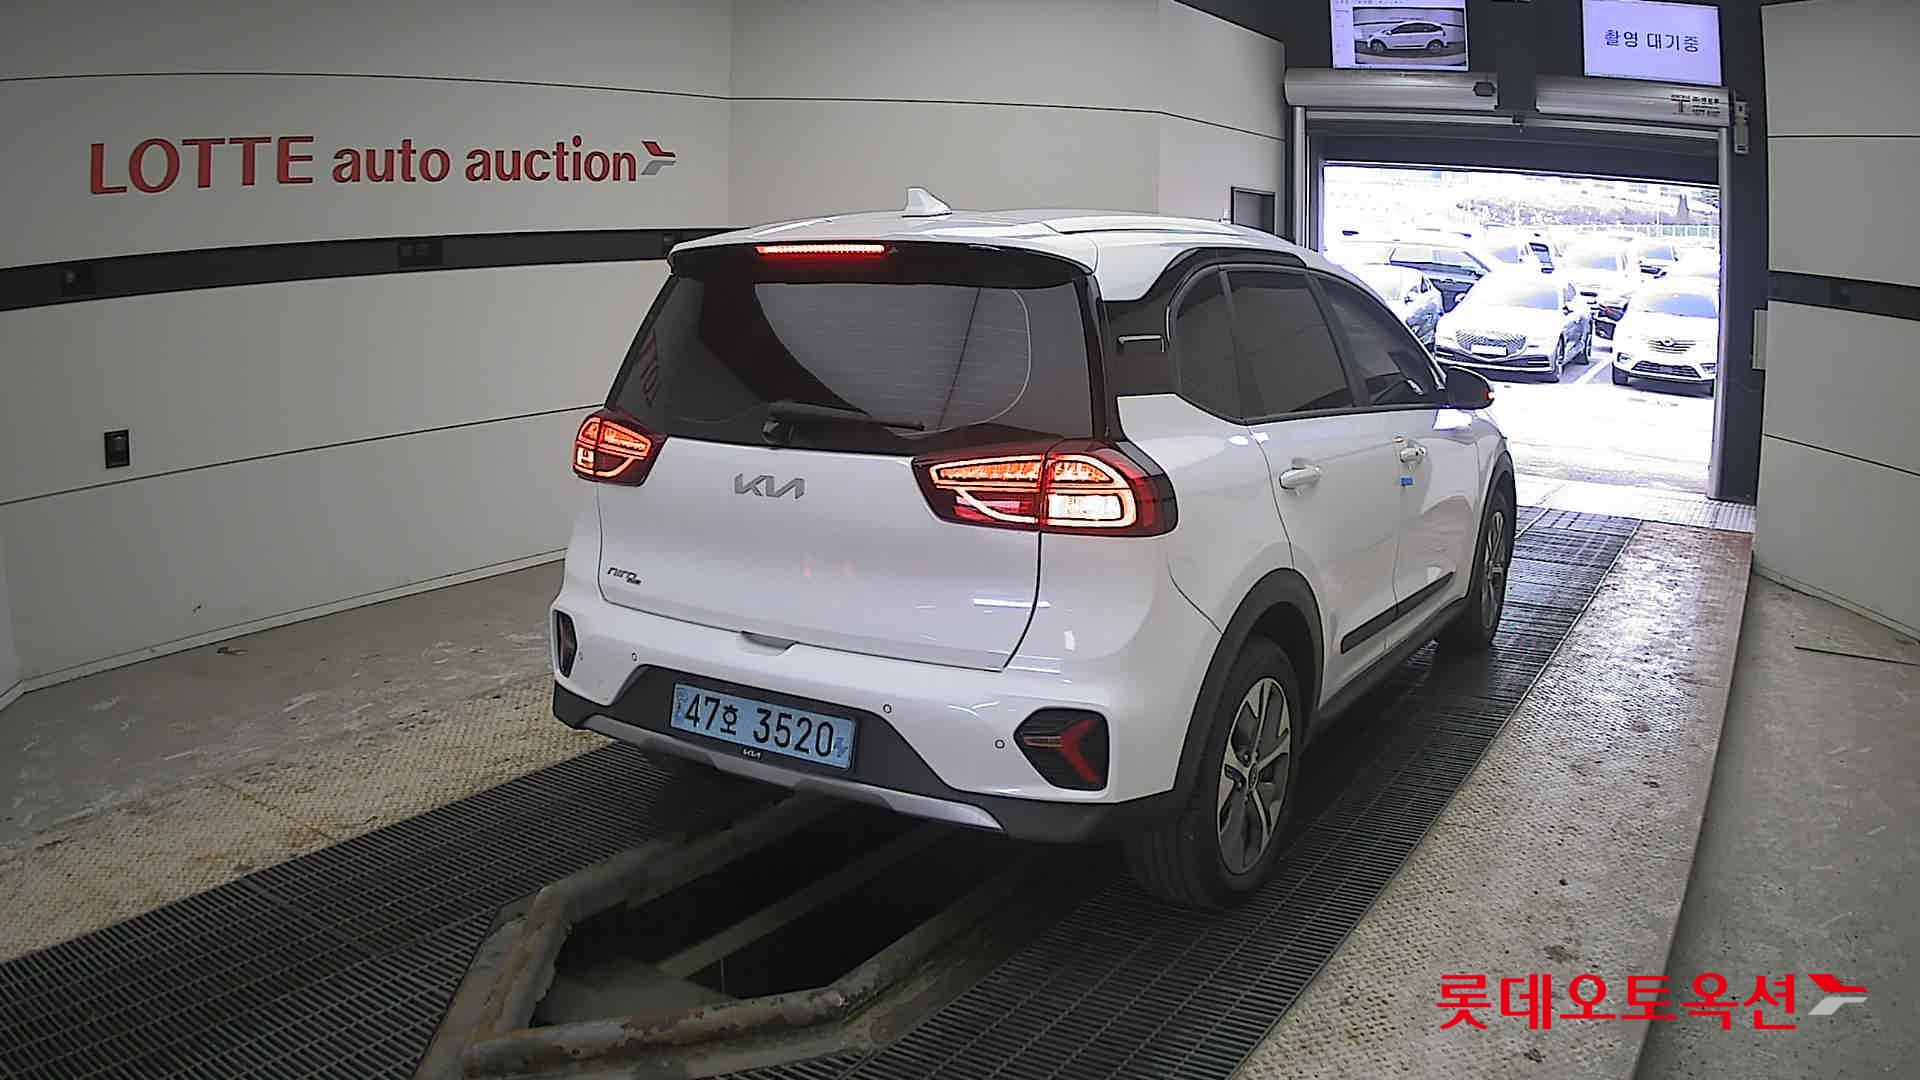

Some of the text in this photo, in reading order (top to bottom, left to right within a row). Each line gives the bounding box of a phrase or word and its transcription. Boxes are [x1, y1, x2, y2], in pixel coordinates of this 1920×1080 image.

[1604, 29, 1699, 53] 촬영 대기중
[89, 135, 638, 195] LOTTE auto auction
[684, 693, 738, 736] 47호
[752, 707, 834, 757] 3520
